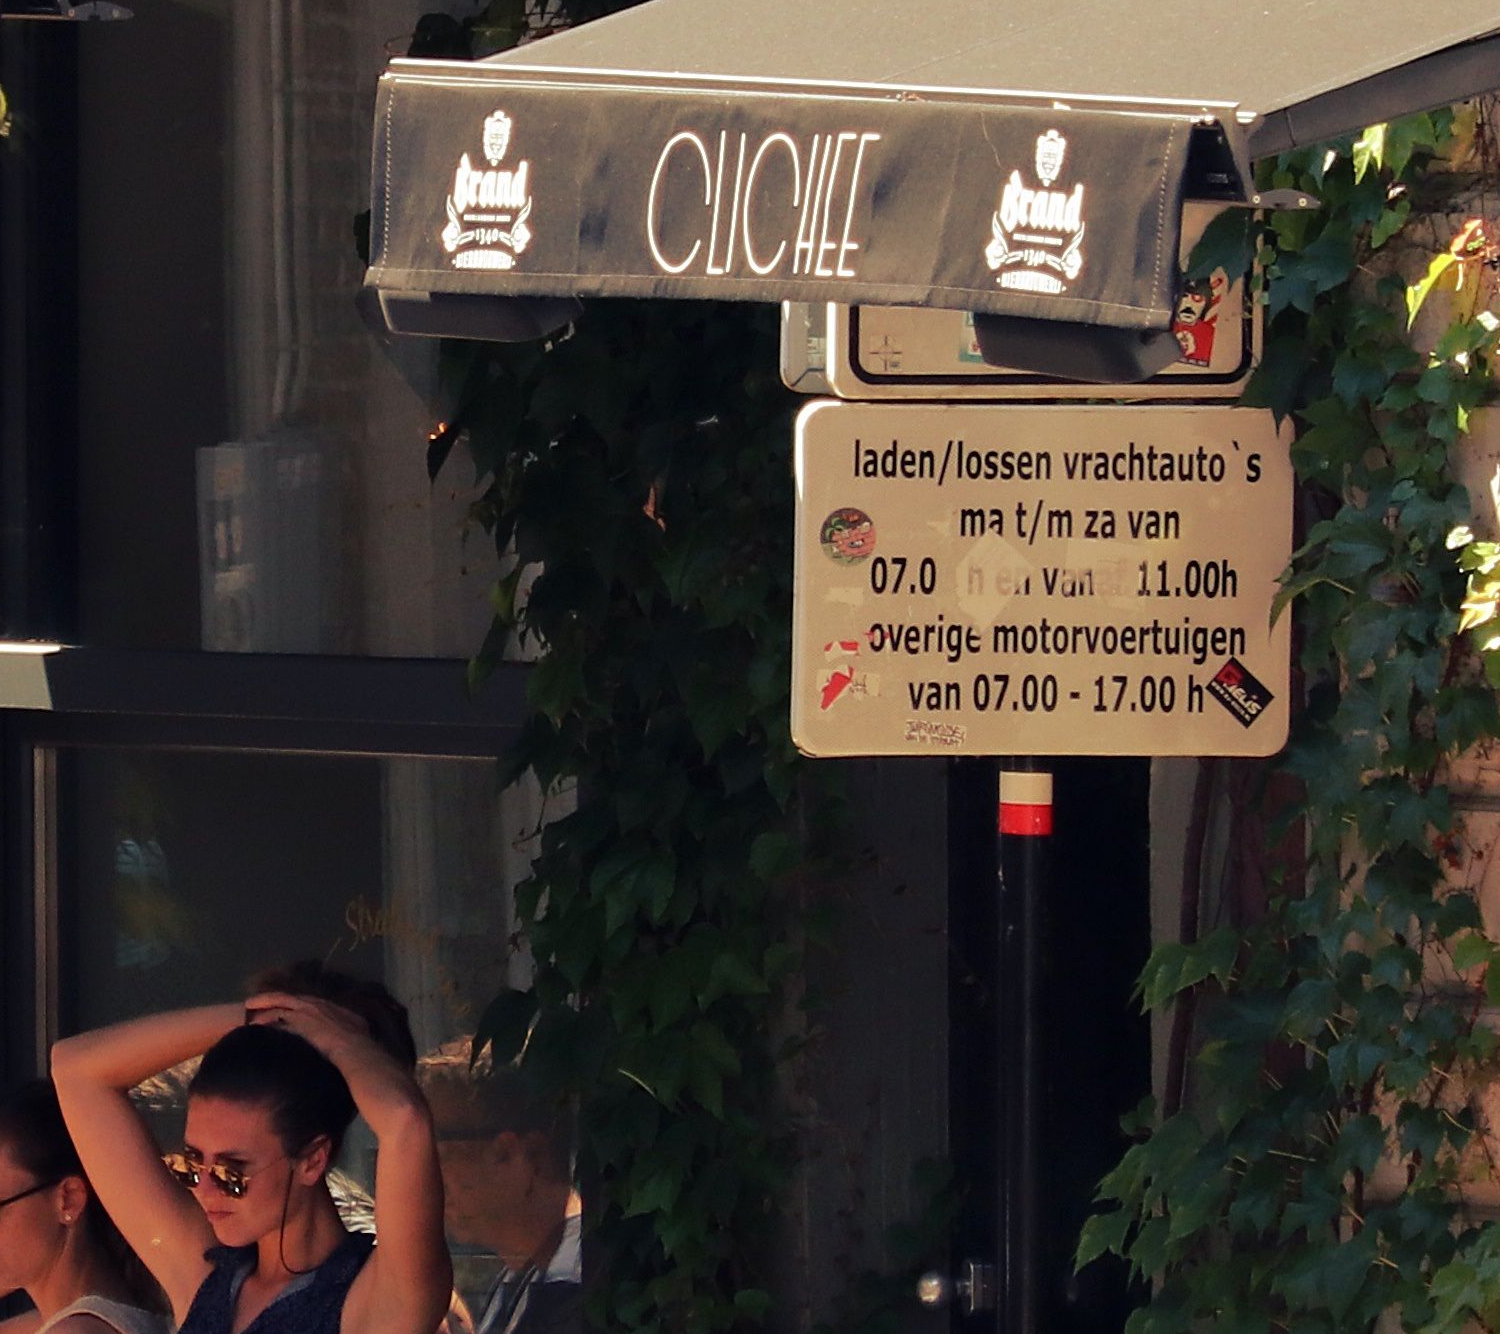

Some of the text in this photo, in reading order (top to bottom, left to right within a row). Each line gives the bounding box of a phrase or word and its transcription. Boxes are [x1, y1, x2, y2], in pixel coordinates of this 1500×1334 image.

[453, 152, 529, 214] Brand
[647, 129, 882, 278] CLICHEE
[999, 169, 1084, 234] Brand
[853, 439, 1052, 486] laden/lossen
[960, 499, 1181, 545] ma t/m za van
[870, 556, 937, 596] 07.0
[869, 615, 1246, 666] overige motorvoertuigen
[909, 679, 961, 712] van
[973, 674, 1059, 713] 07.00
[1093, 675, 1177, 713] 17.00
[1188, 674, 1204, 713] h
